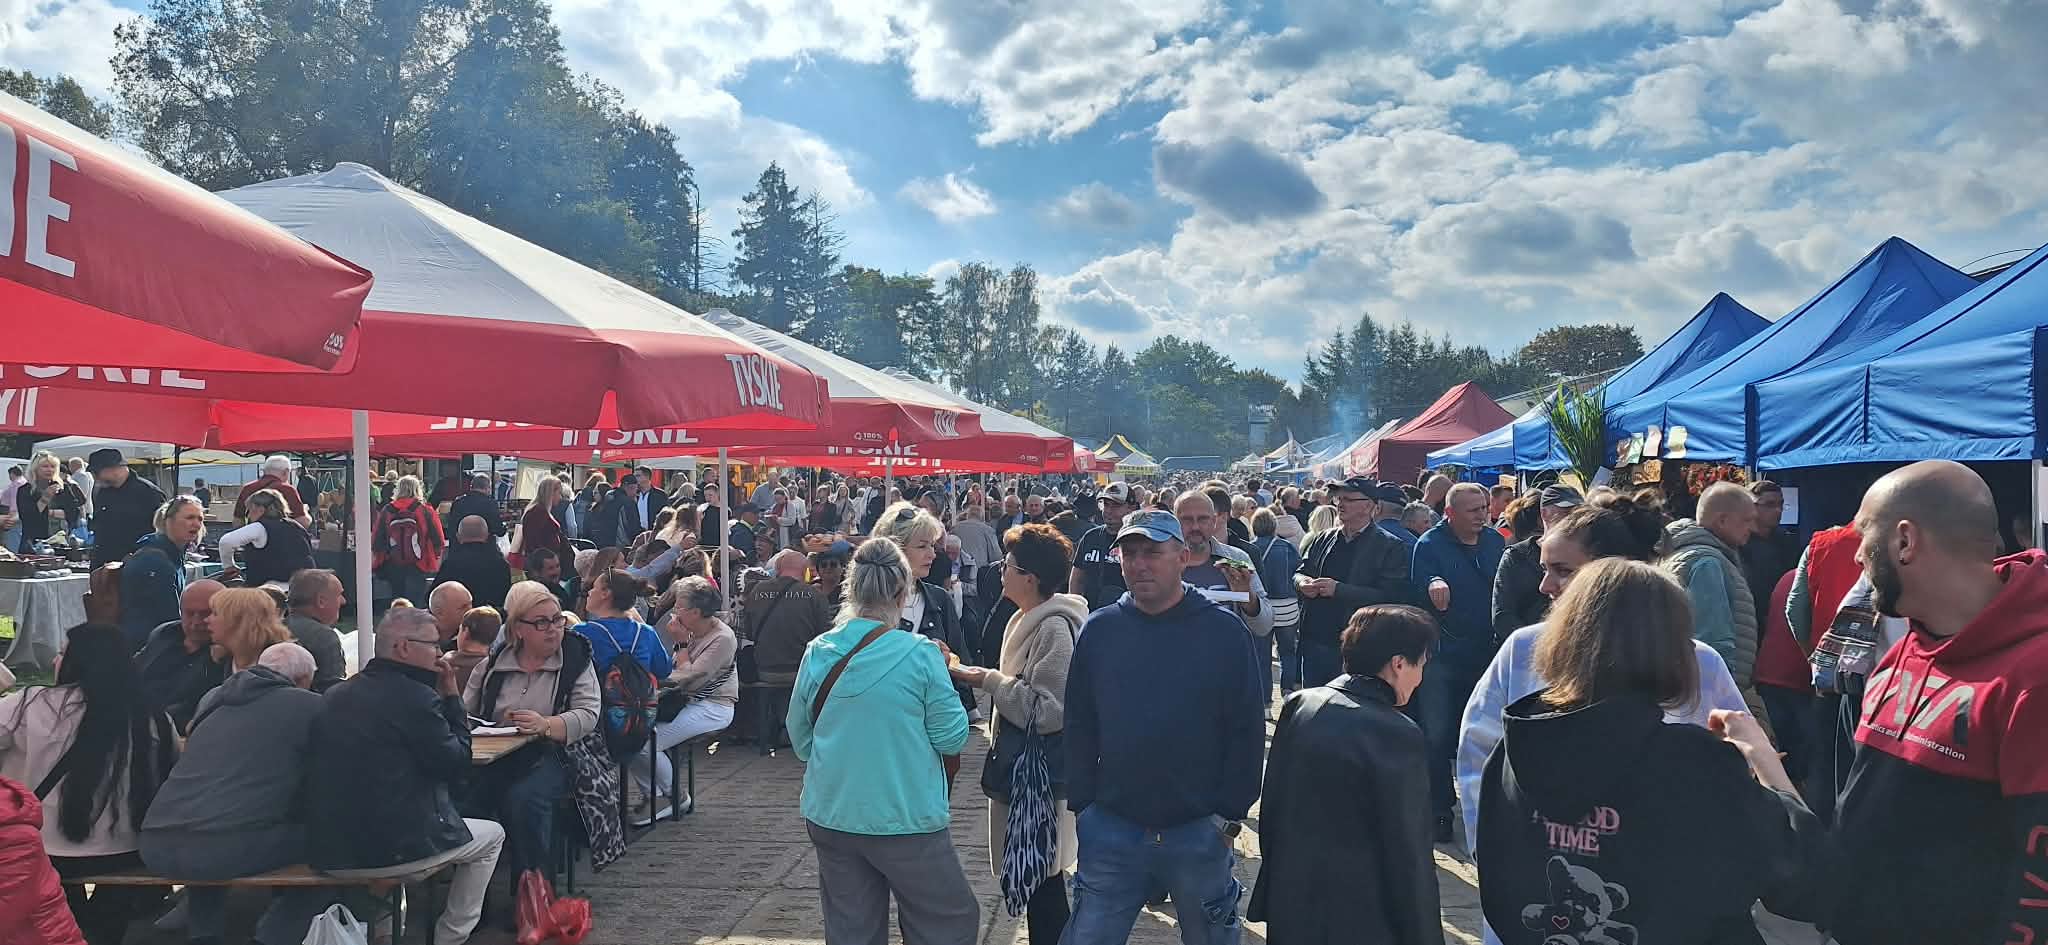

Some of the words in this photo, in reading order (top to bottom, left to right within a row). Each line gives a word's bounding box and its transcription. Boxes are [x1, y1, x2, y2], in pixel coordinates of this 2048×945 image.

[724, 353, 784, 411] TYSKIE
[754, 591, 814, 600] SSETIALS
[1545, 822, 1600, 853] TIME
